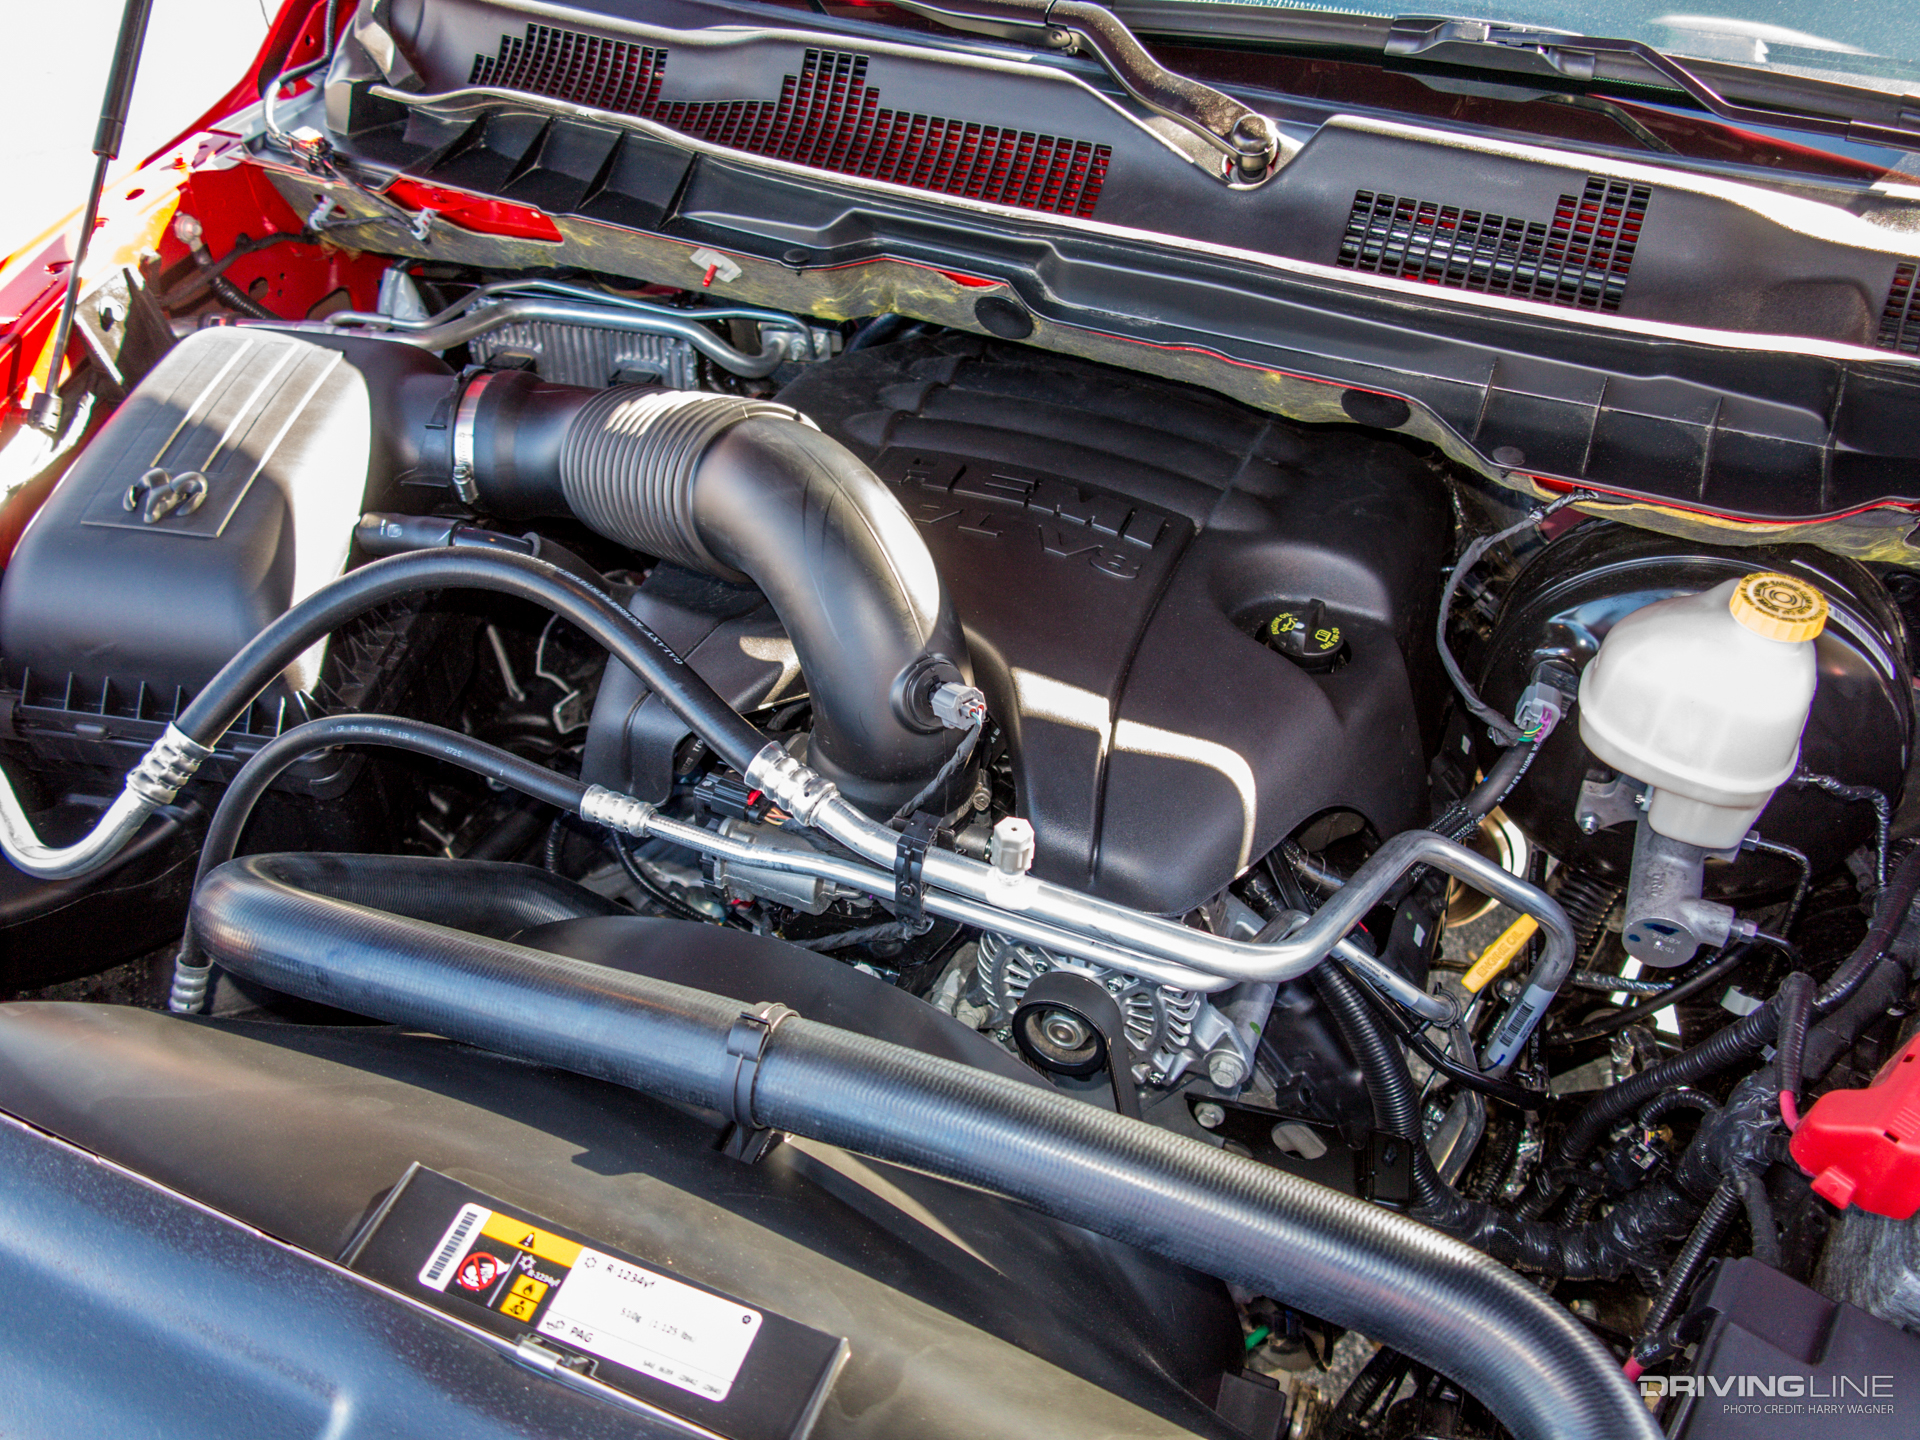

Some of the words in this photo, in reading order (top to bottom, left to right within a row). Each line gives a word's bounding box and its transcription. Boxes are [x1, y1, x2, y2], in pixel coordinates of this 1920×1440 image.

[878, 452, 1167, 549] HEMI
[1037, 523, 1142, 579] V8
[642, 629, 684, 665] GALAXY
[444, 746, 462, 758] 2725
[1476, 943, 1508, 978] ENGINE
[1506, 930, 1524, 945] OIL
[606, 1264, 656, 1288] R-1234yf
[570, 1326, 593, 1342] PAG
